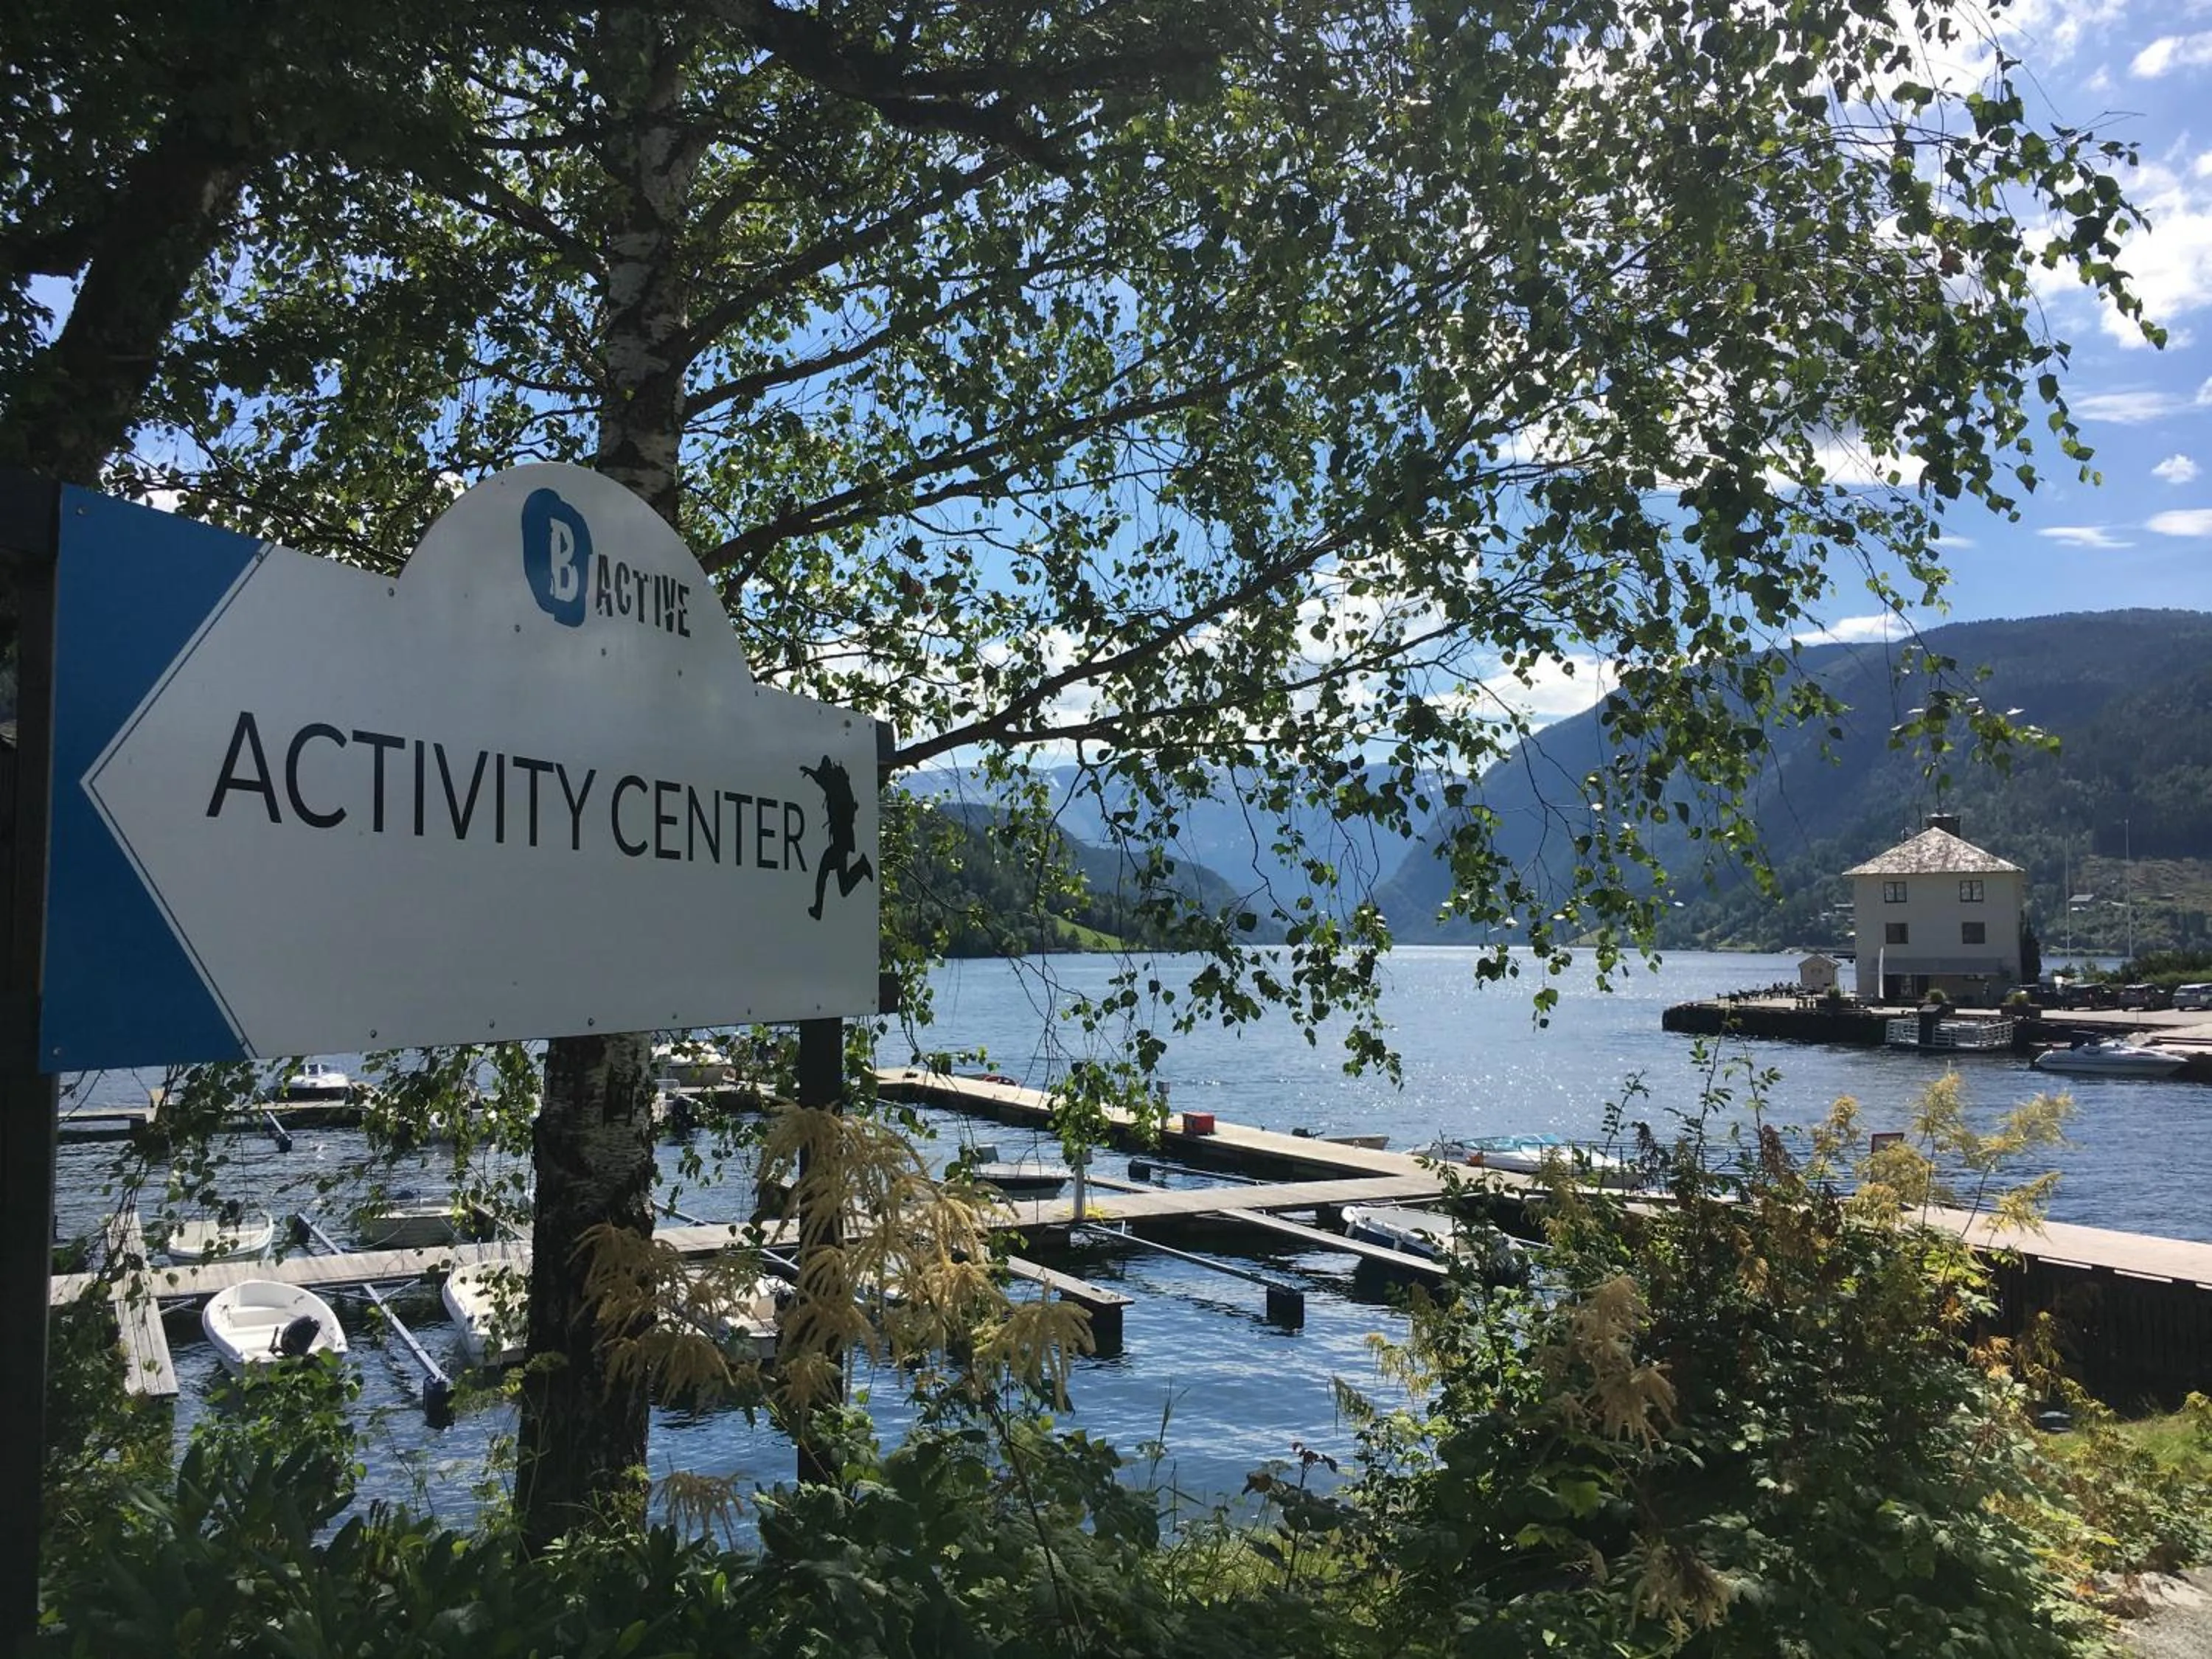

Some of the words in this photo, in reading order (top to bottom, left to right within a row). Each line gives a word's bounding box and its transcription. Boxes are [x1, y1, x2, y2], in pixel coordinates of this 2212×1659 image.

[549, 518, 580, 603] B
[596, 554, 691, 638] ACTIVE
[206, 711, 597, 850] ACTIVITY
[611, 775, 807, 872] CENTER
